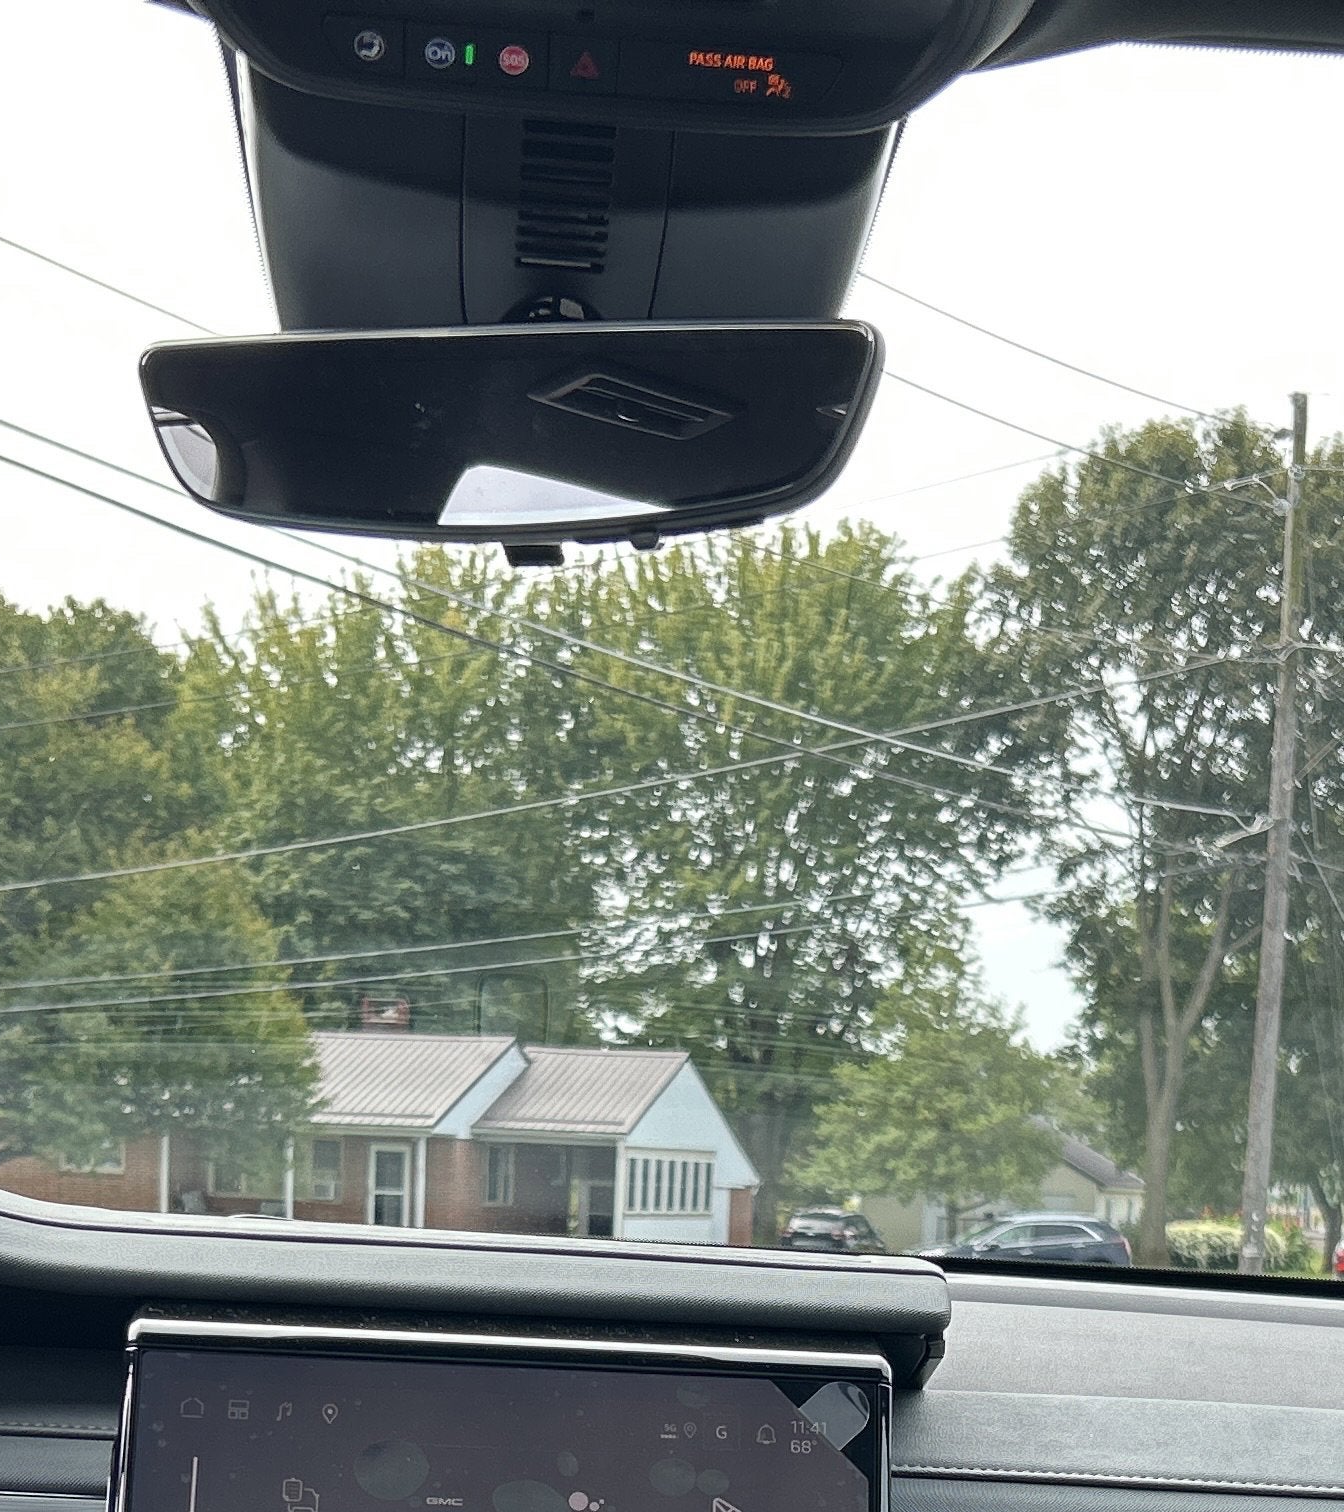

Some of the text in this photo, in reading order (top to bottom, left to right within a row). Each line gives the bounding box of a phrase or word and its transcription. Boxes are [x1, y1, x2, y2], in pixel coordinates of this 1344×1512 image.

[502, 54, 525, 66] SOS
[689, 51, 774, 71] PASS AIR BAG
[734, 79, 757, 93] OFF
[791, 1421, 827, 1435] 11:41
[426, 1497, 463, 1506] GMC
